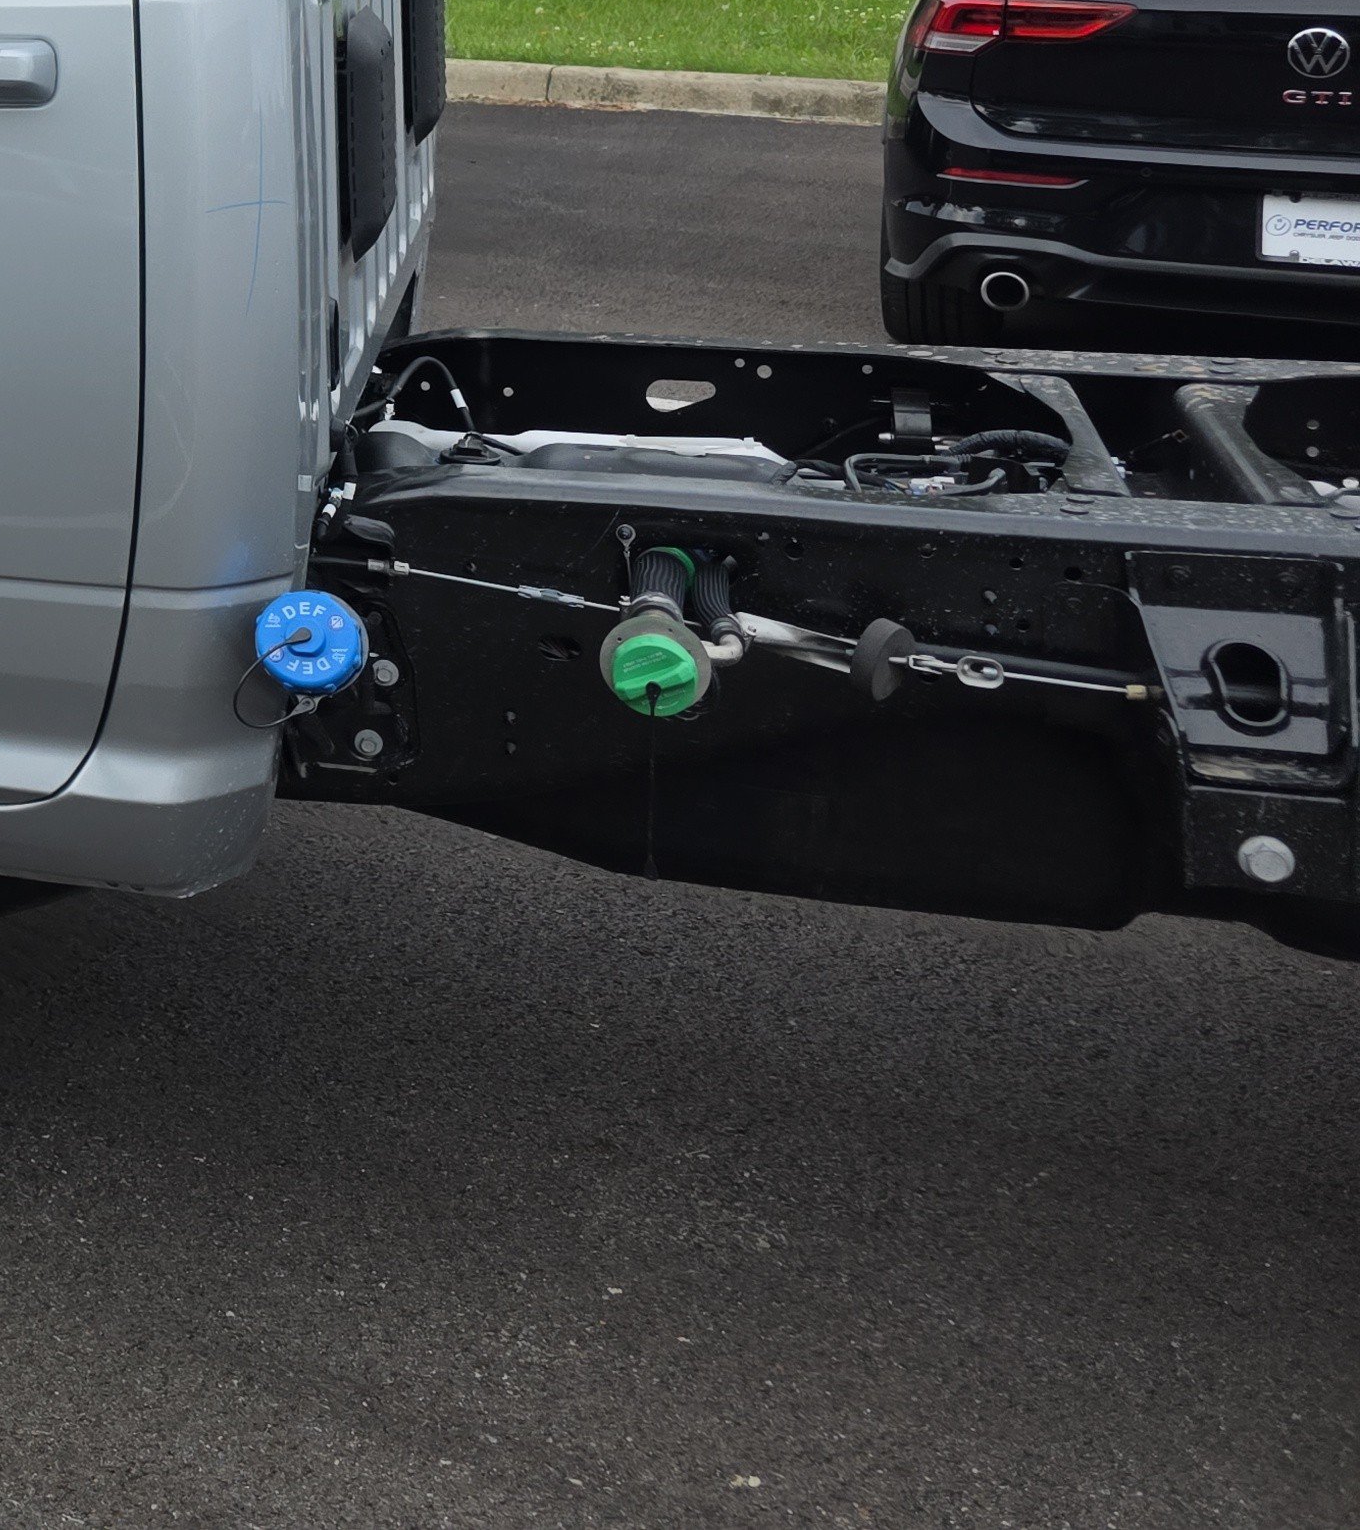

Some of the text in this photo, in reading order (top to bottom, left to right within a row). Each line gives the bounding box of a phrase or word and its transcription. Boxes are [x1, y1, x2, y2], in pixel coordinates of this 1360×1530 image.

[1282, 90, 1353, 105] GTI
[281, 601, 327, 620] DEF
[286, 657, 332, 675] DEF
